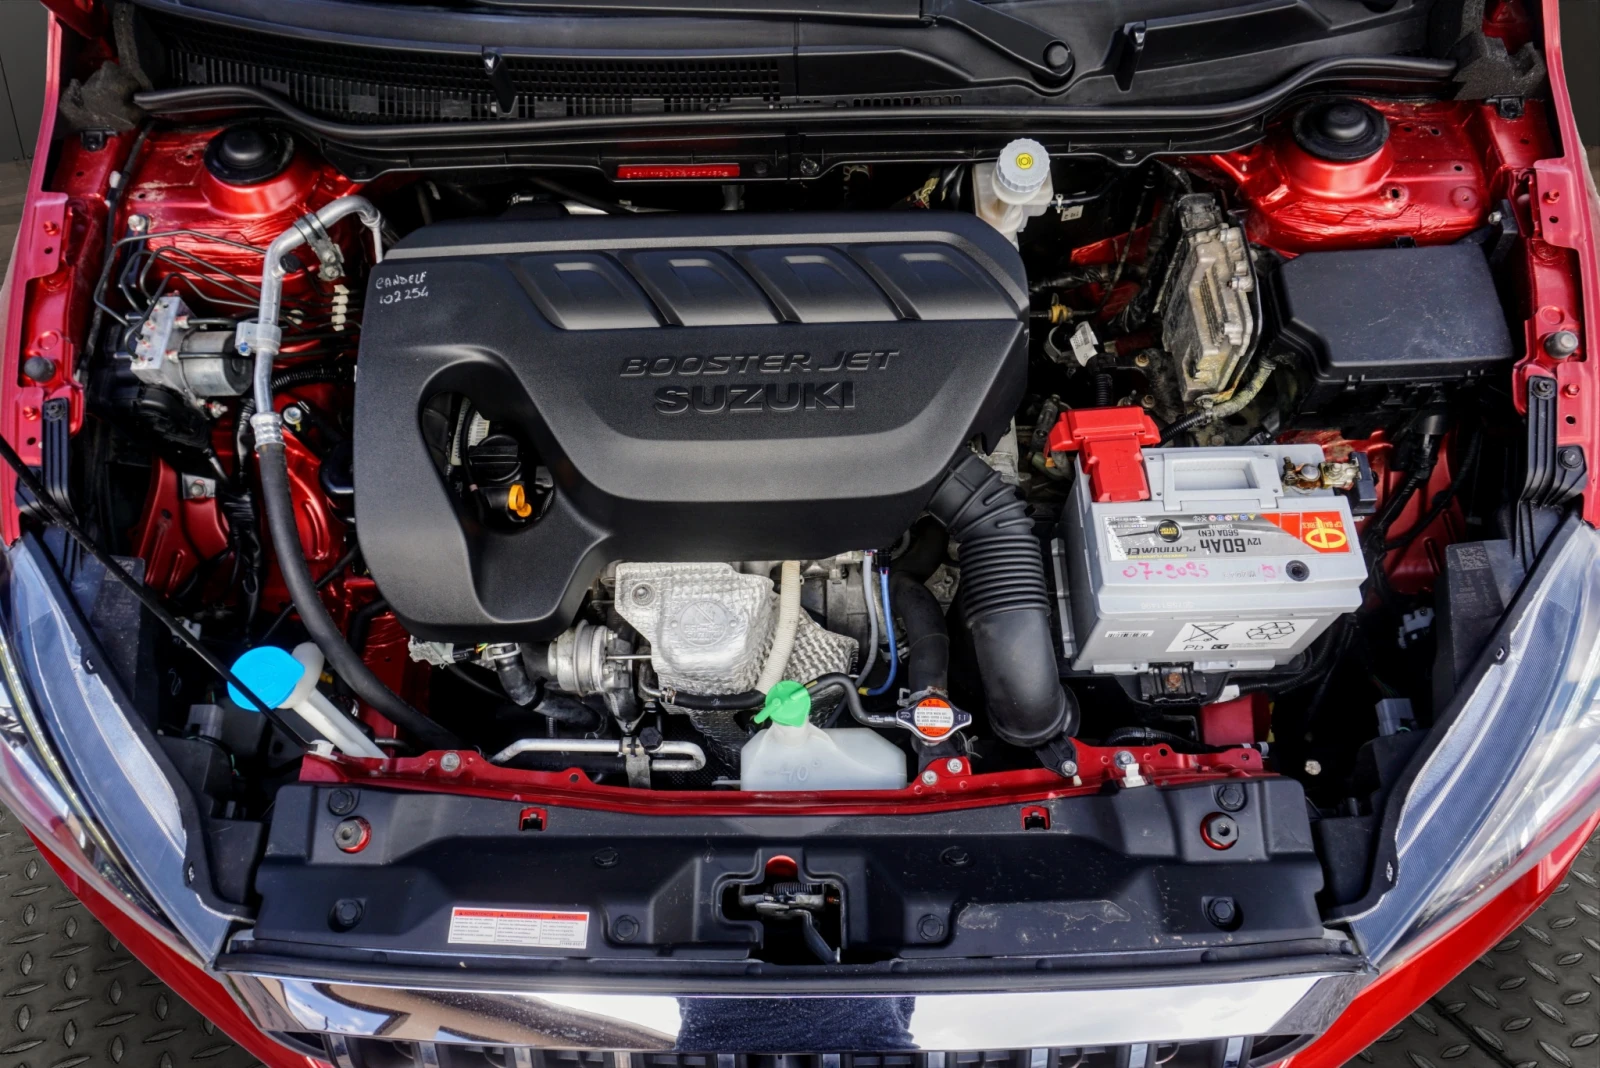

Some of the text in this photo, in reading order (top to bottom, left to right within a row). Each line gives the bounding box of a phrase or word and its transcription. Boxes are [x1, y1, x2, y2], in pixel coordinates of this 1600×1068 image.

[619, 350, 900, 378] BOOSTER JET
[653, 381, 856, 415] SUZUKI
[1198, 529, 1239, 537] 560A (EN)
[1142, 546, 1196, 554] PLATINUM
[1200, 537, 1262, 554] 12V 60Ah
